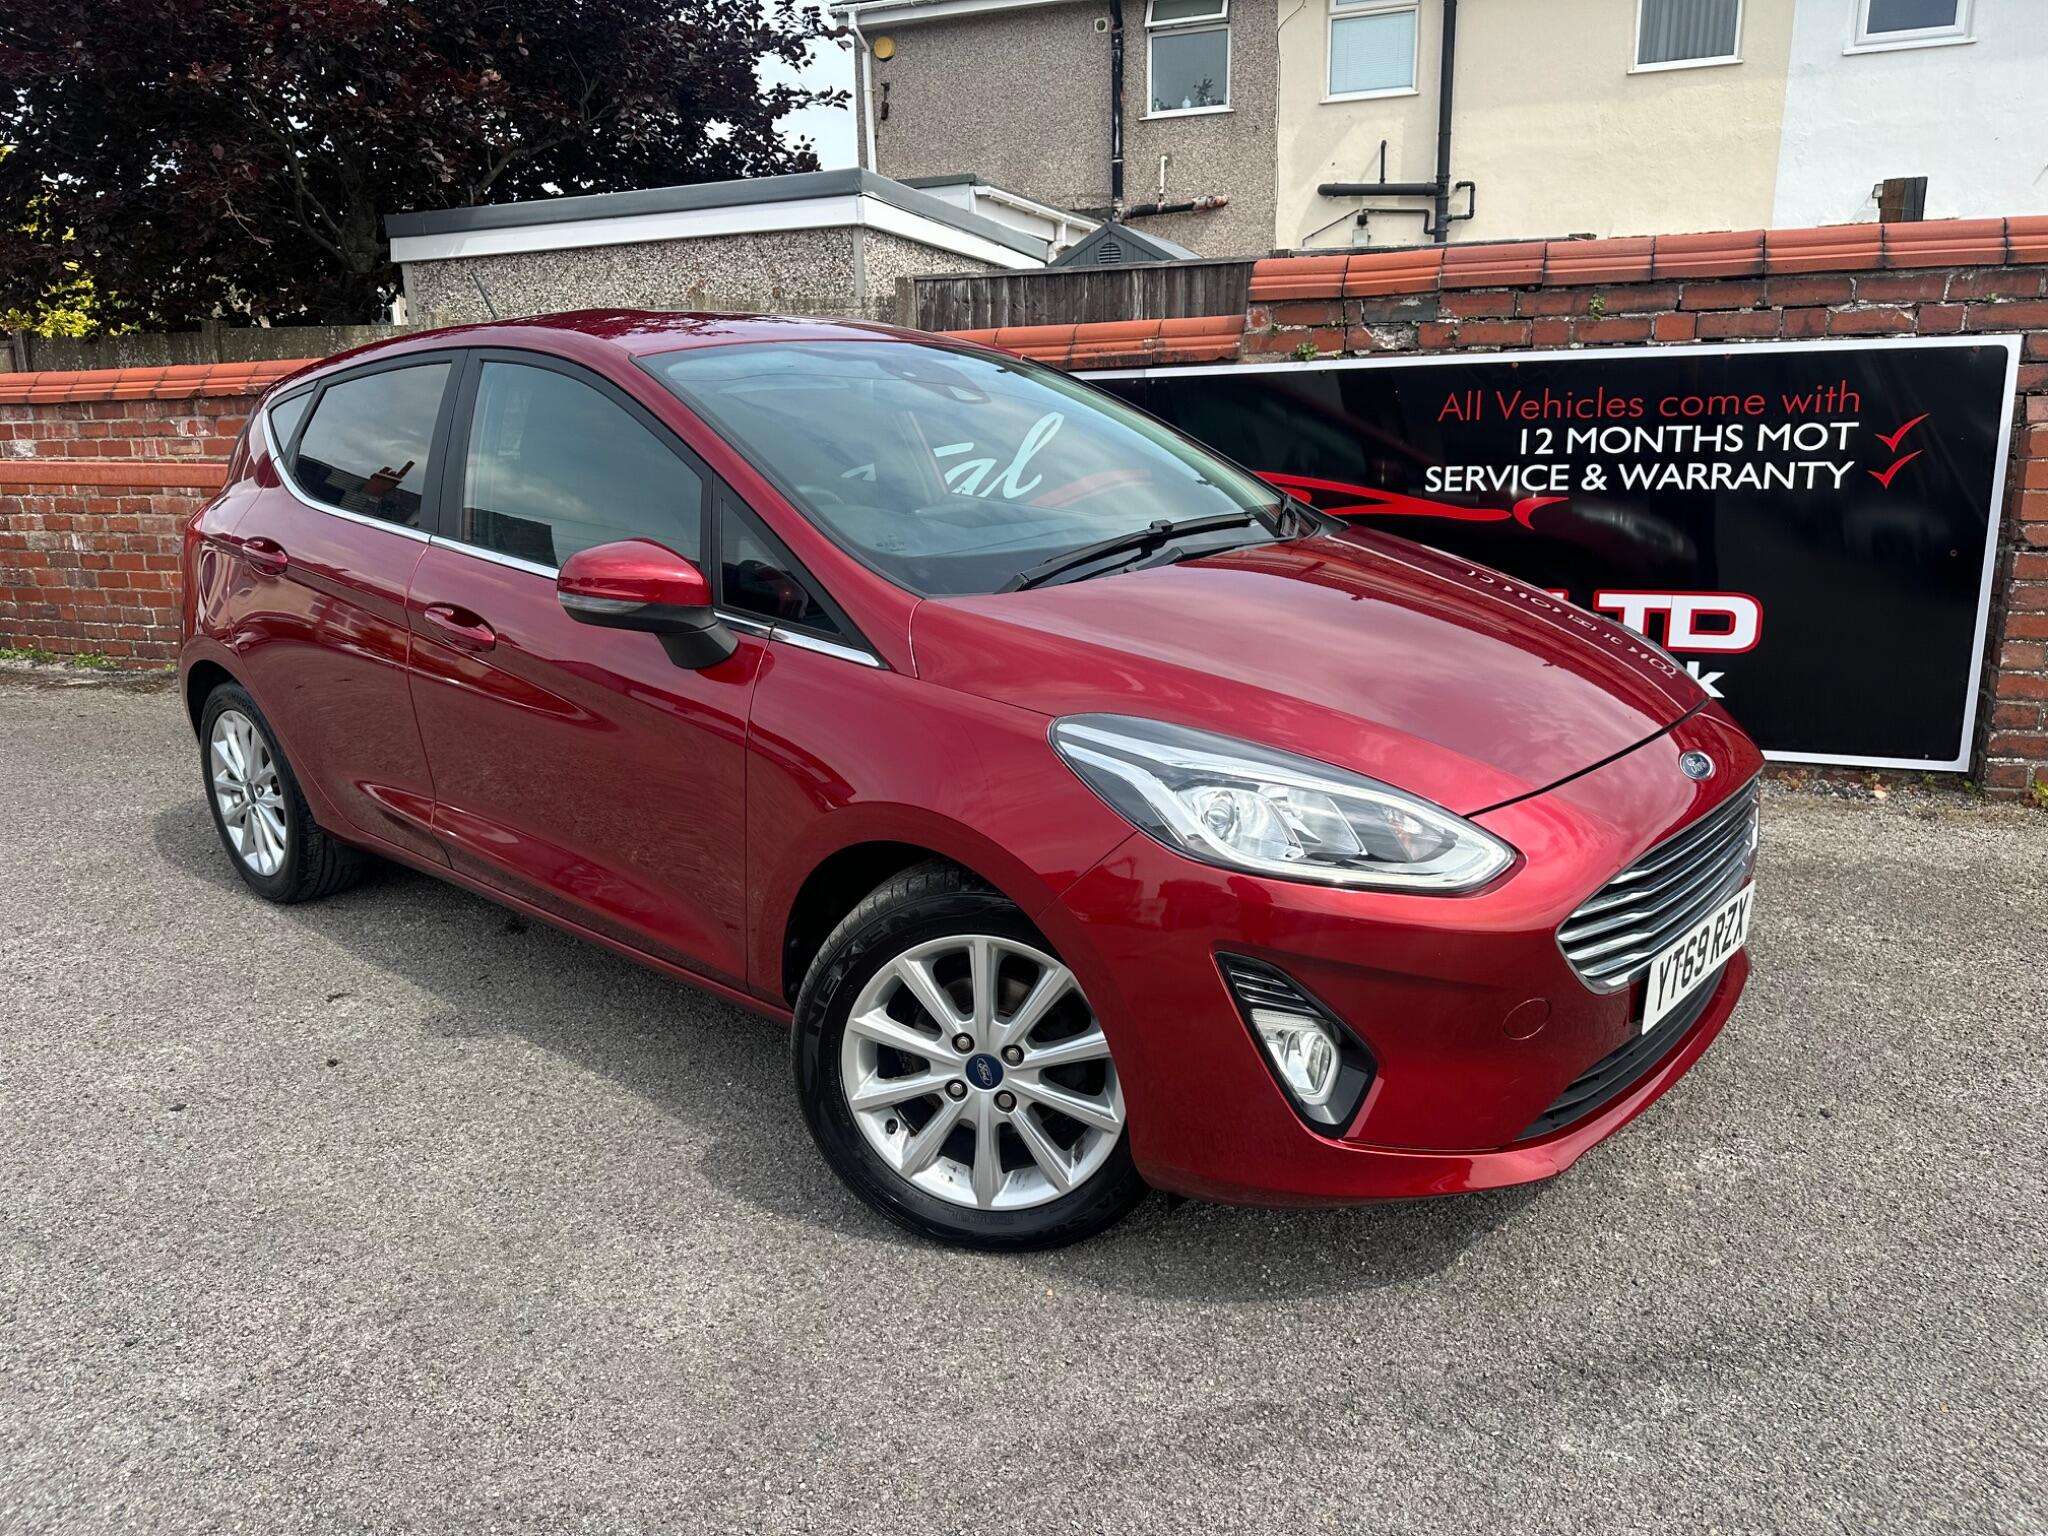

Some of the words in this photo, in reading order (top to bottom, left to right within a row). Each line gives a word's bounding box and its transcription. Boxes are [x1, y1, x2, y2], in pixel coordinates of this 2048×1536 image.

[1438, 389, 1482, 421] All
[1495, 386, 1644, 420] Vehicles
[1659, 393, 1765, 417] come
[1782, 380, 1860, 414] with
[1520, 427, 1554, 455] 12
[1566, 423, 1743, 454] MONTHS
[1757, 421, 1860, 452] MOT
[1424, 464, 1570, 493] SERVICE
[1580, 463, 1608, 491] &
[1618, 460, 1855, 491] WARRANTY
[1549, 588, 1764, 654] TD
[1656, 924, 1710, 1012] YT69
[1709, 892, 1749, 965] RZX
